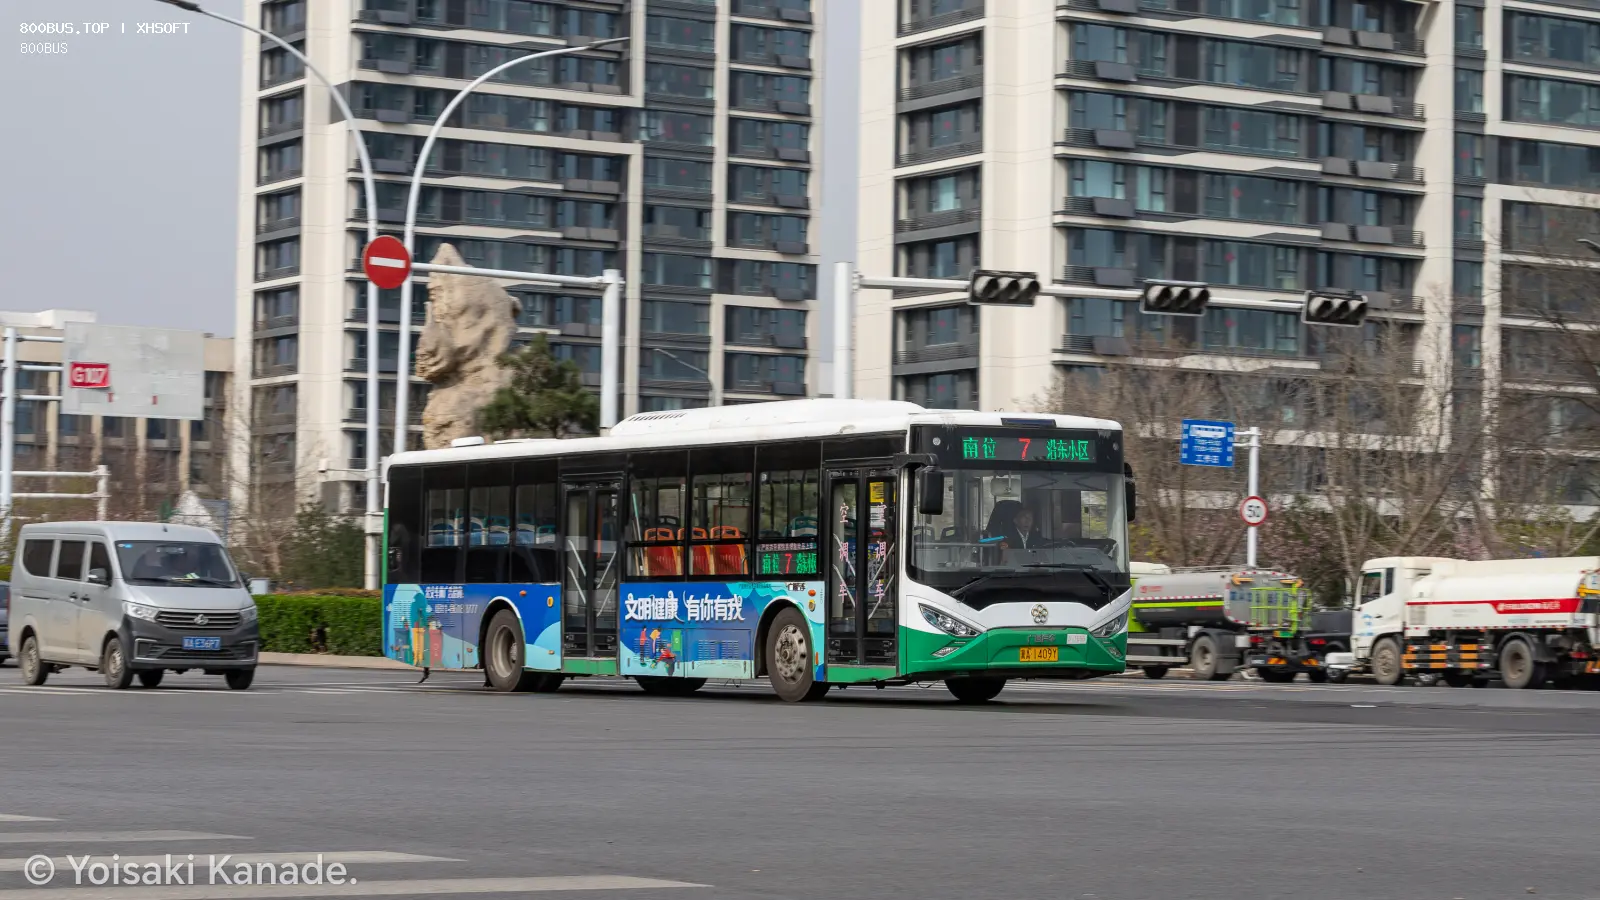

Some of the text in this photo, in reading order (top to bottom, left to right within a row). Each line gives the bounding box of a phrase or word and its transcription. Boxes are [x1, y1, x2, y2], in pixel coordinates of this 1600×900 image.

[1018, 438, 1031, 460] 7
[1046, 439, 1090, 461] 沿东小区
[784, 553, 793, 574] 7
[624, 590, 746, 623] 文明健康 有你有我
